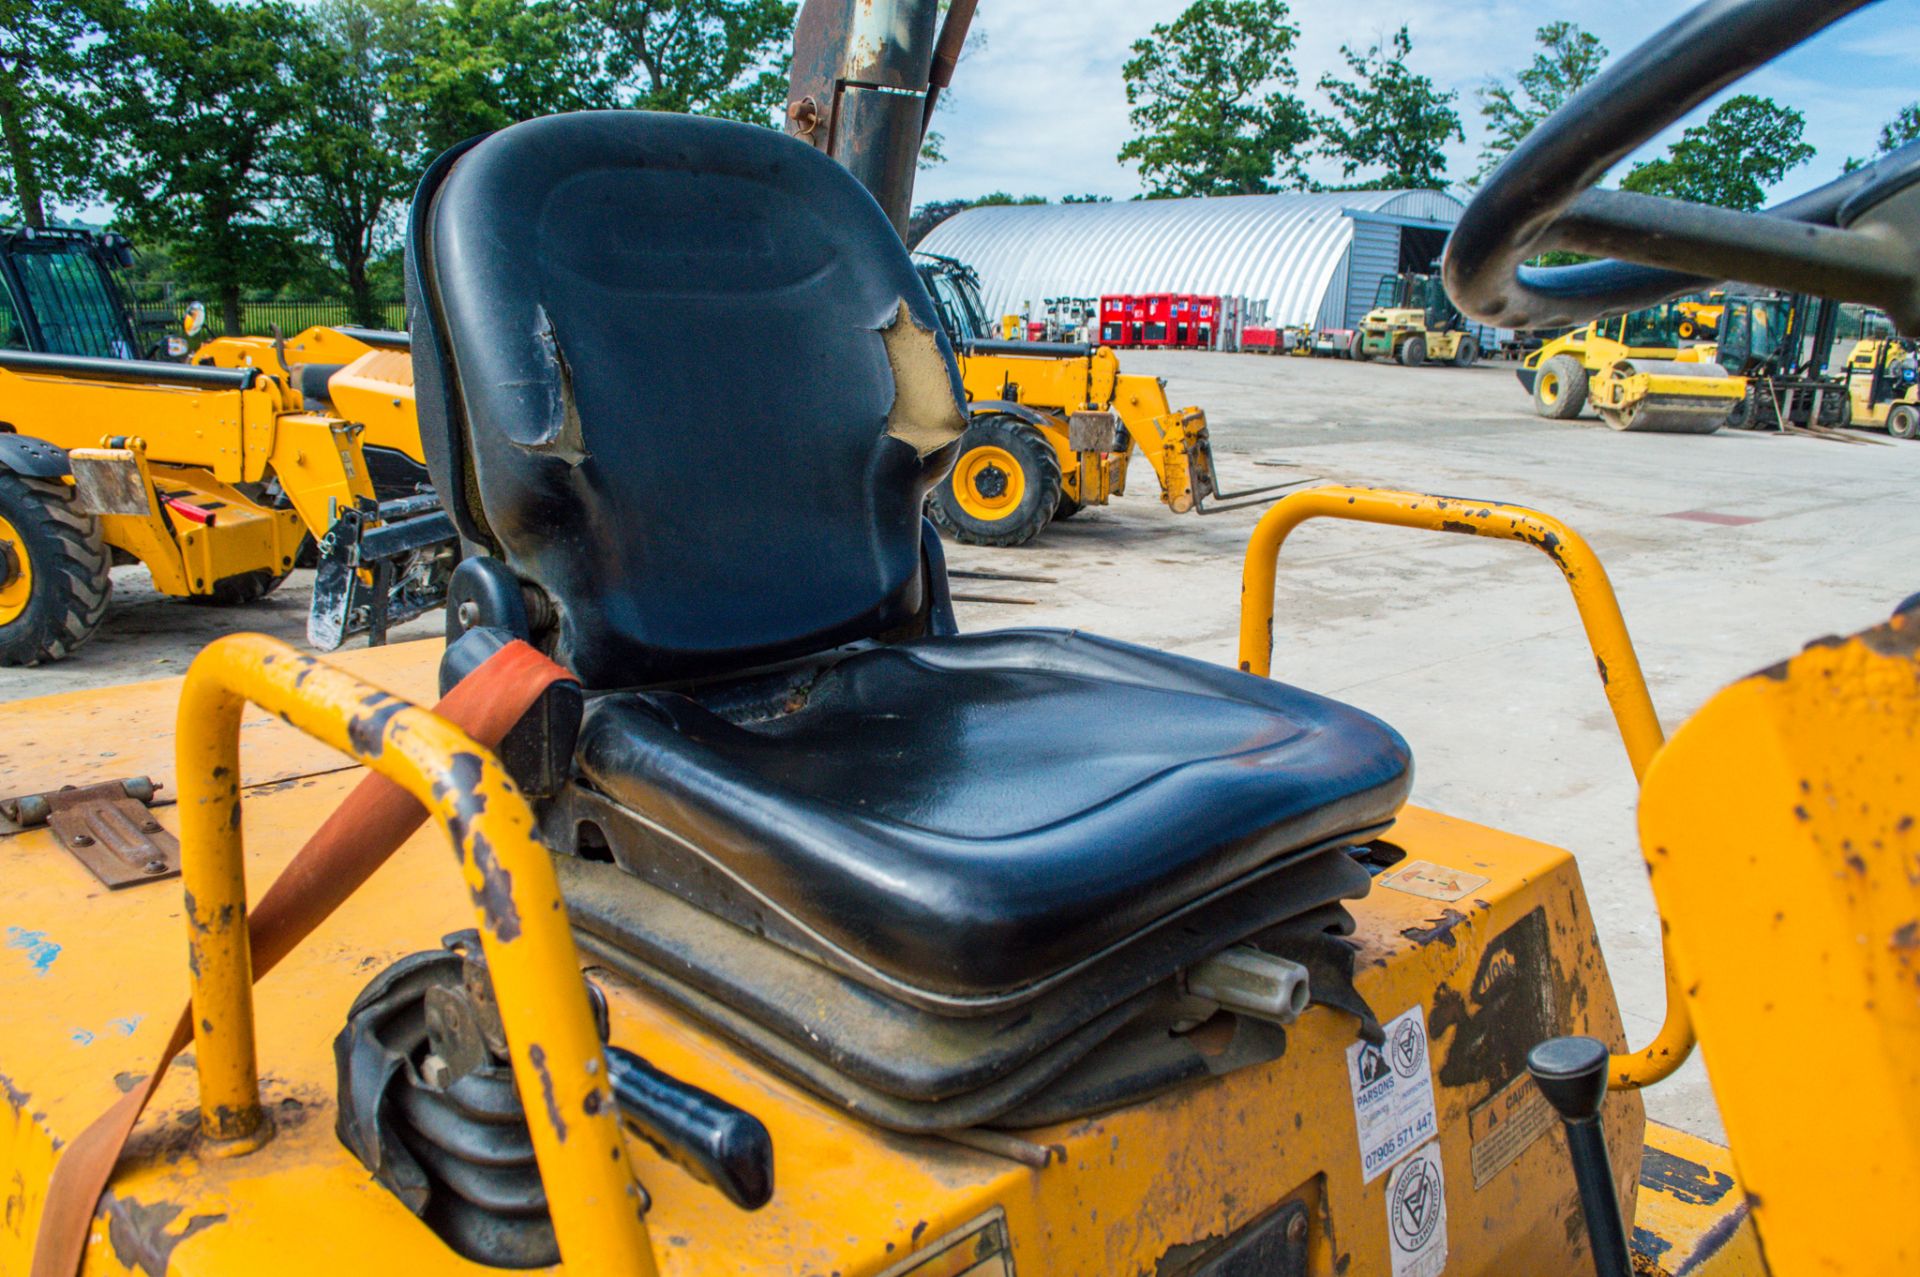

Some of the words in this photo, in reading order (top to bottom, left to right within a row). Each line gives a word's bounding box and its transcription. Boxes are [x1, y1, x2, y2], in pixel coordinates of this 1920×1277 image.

[1357, 1076, 1395, 1108] PARSONS
[1505, 1078, 1535, 1110] CAUTI
[1365, 1138, 1395, 1169] 07905
[1397, 1125, 1413, 1147] 571
[1416, 1111, 1432, 1132] 447
[1394, 1164, 1421, 1222] THOROUGH
[1410, 1178, 1440, 1248] EXAMINATION
